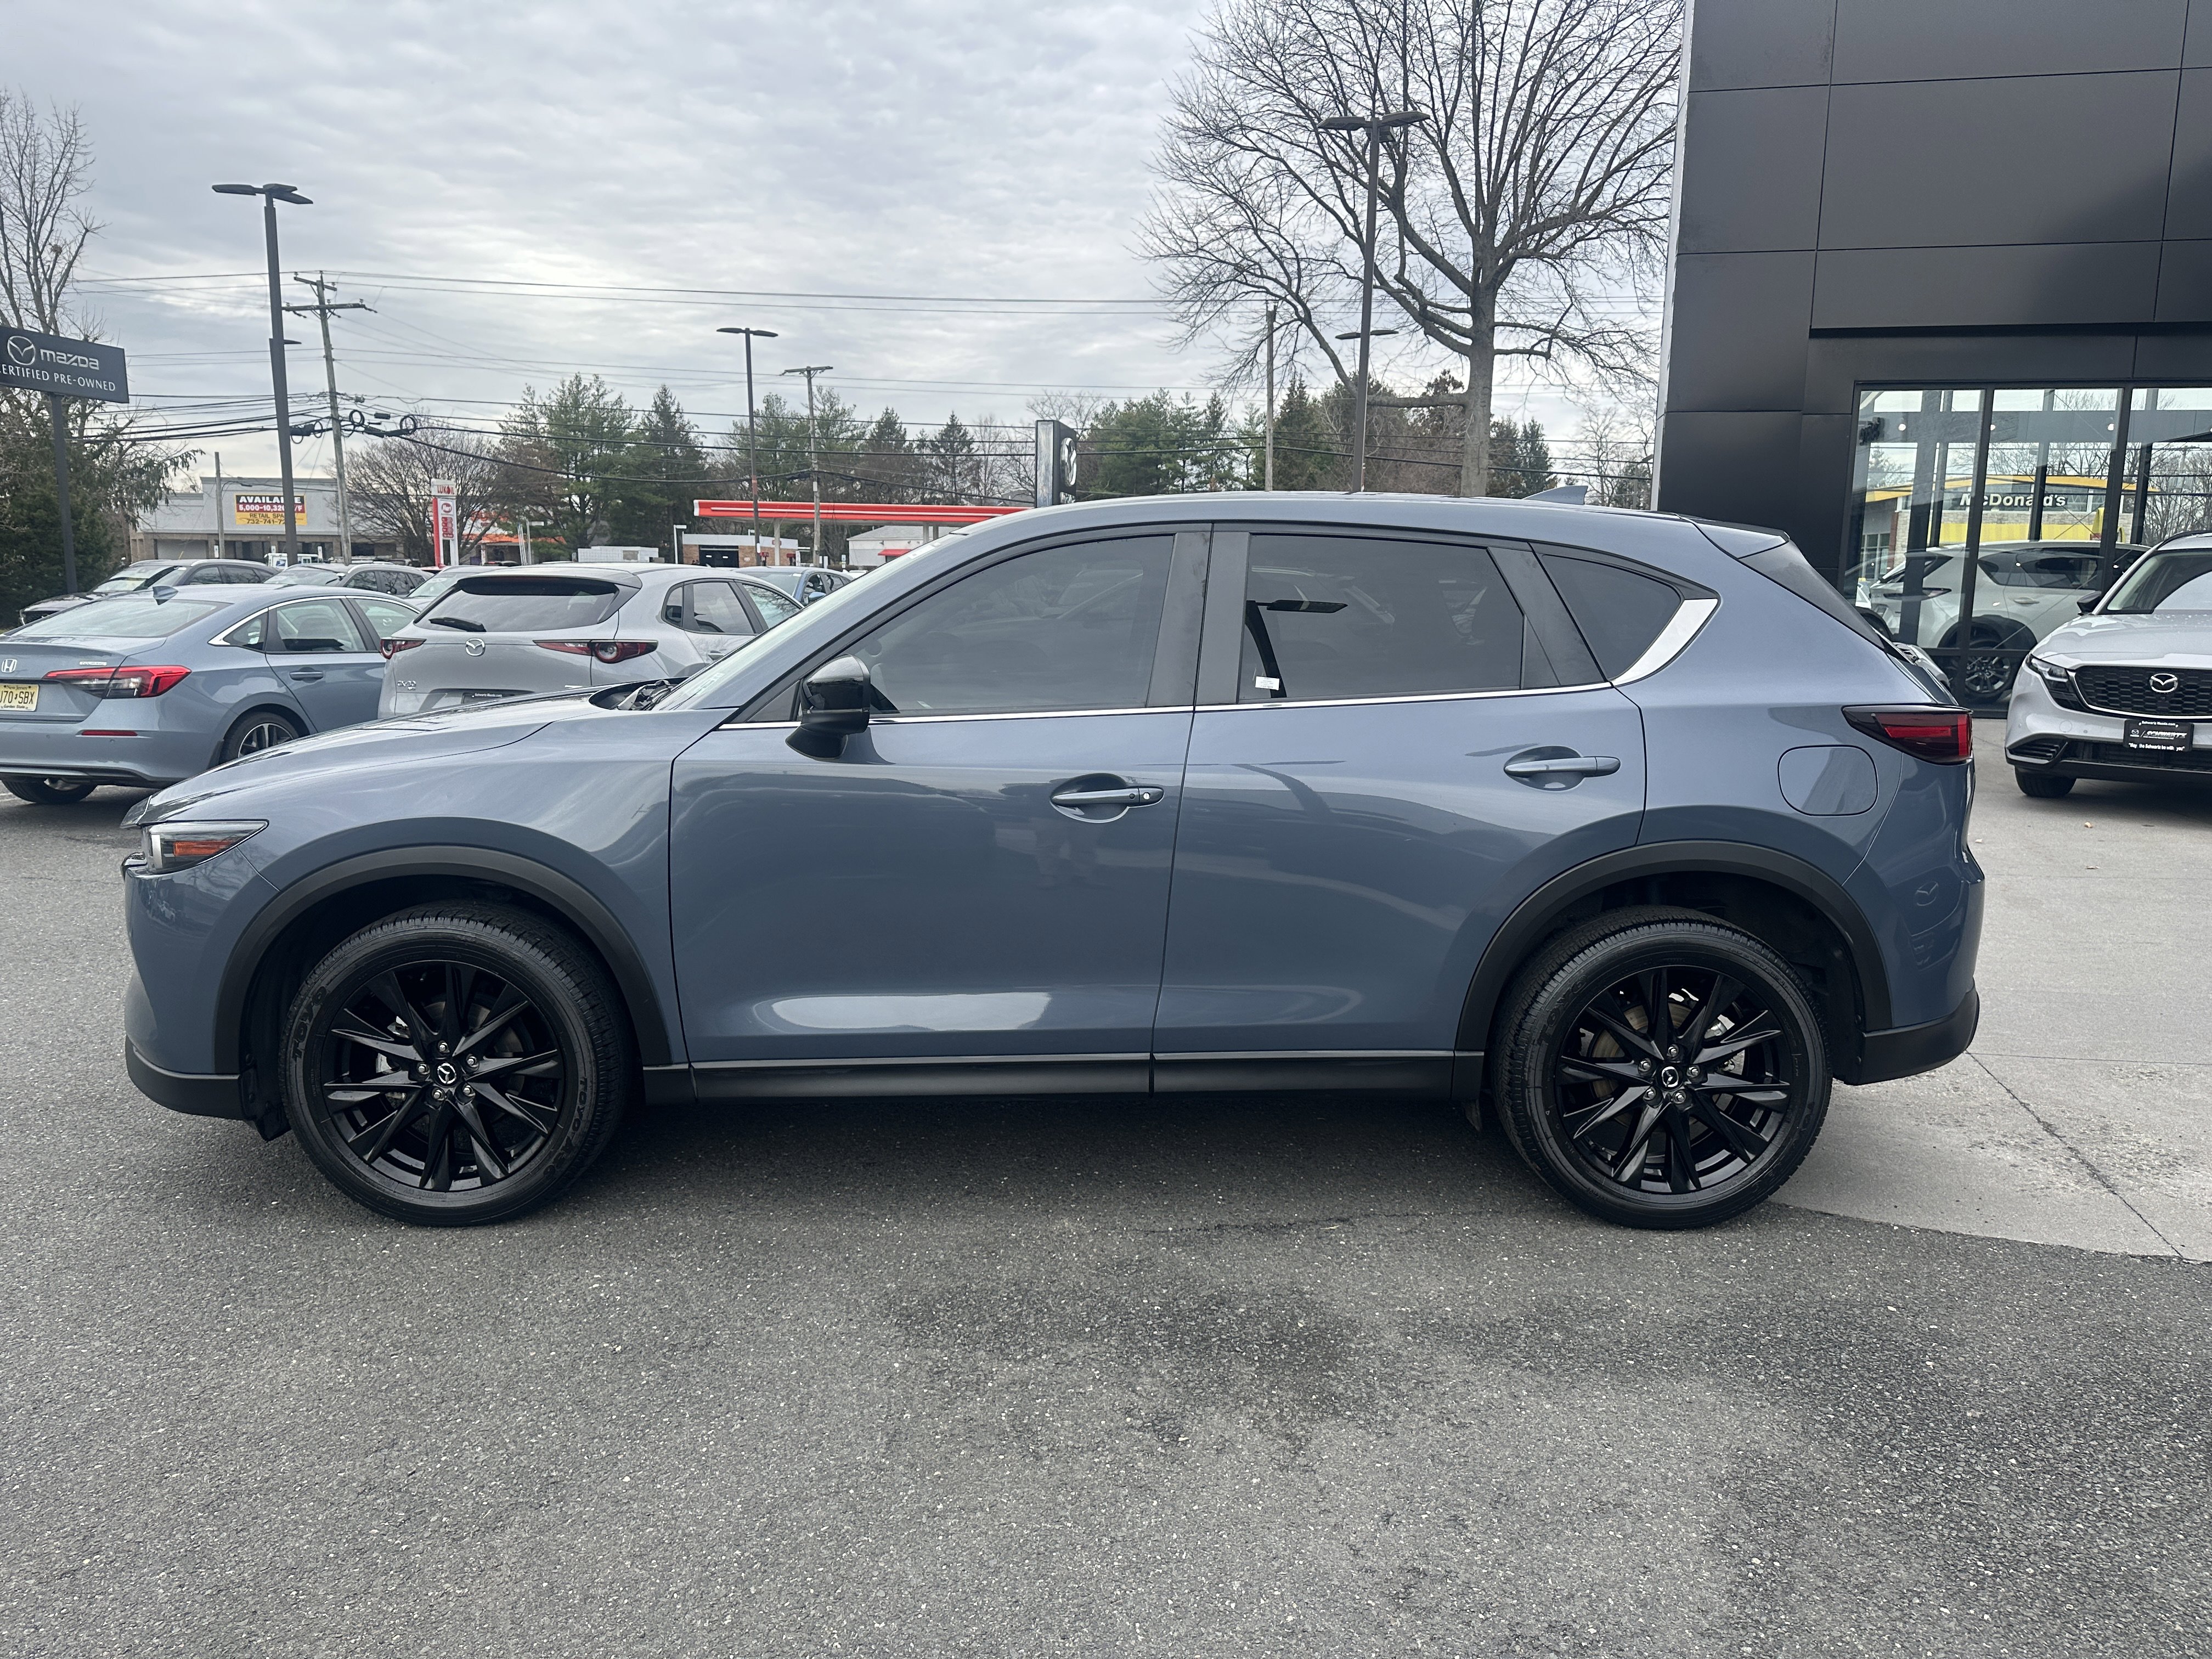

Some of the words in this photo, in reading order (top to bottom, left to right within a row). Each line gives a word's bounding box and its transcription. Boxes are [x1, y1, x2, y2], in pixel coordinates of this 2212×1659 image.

[40, 348, 99, 370] mazda
[0, 364, 49, 381] ERTIFIED
[54, 373, 115, 391] PRE-OWNED
[437, 485, 454, 495] LUKOIL
[1960, 493, 2066, 506] McDonad's
[18, 691, 35, 704] SBX
[292, 986, 328, 1060] TOYO
[572, 1076, 588, 1132] TOYO
